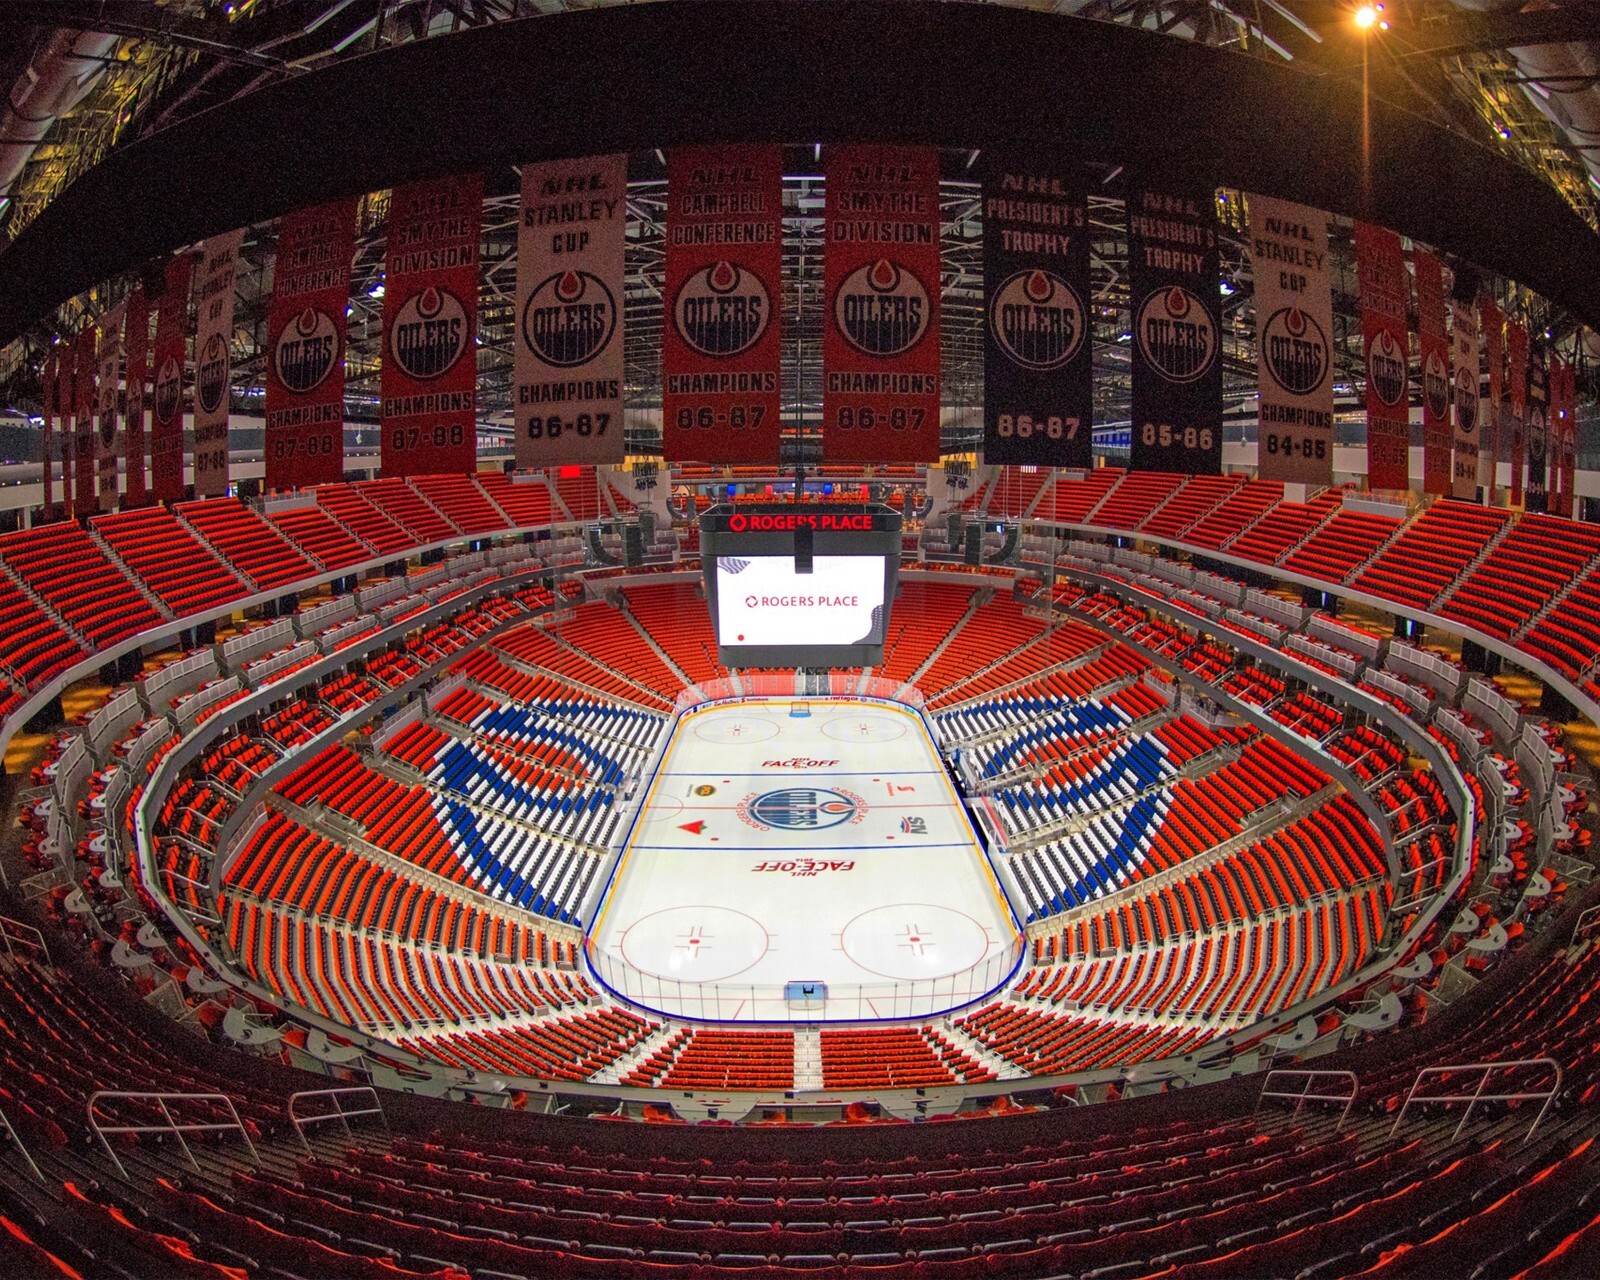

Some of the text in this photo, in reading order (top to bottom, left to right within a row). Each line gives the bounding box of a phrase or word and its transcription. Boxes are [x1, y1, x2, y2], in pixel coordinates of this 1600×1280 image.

[541, 174, 607, 196] NHL
[690, 166, 761, 184] NHL
[849, 164, 919, 184] NHL
[1002, 172, 1066, 196] NHL
[524, 198, 618, 228] STANLEY
[680, 192, 768, 216] CAMPBELL
[838, 191, 928, 214] SMYTHE
[672, 222, 776, 246] CONFERENCE
[832, 221, 932, 244] DIVISION
[1265, 216, 1314, 242] NHL
[552, 231, 589, 254] CUP
[1001, 230, 1070, 256] TROPHY
[391, 244, 474, 276] DIVISION
[1144, 246, 1204, 275] TROPHY
[1254, 241, 1325, 272] STANLEY
[277, 268, 348, 298] CONFERENCE
[1280, 271, 1308, 293] CUP
[533, 303, 606, 337] OILERS
[682, 295, 762, 324] OILERS
[844, 294, 922, 324] OILERS
[1001, 303, 1074, 336] OILERS
[397, 318, 461, 348] OILERS
[1146, 318, 1208, 350] OILERS
[279, 334, 332, 366] OILERS
[1271, 335, 1322, 368] OILERS
[520, 380, 619, 404] CHAMPIONS
[668, 372, 776, 395] CHAMPIONS
[828, 372, 936, 396] CHAMPIONS
[268, 404, 340, 431] CHAMPIONS
[384, 391, 474, 420] CHAMPIONS
[676, 406, 767, 431] 86-87
[1261, 404, 1332, 430] CHAMPIONS
[528, 414, 611, 440] 86-87
[836, 406, 926, 432] 86-87
[996, 414, 1081, 441] 86-87
[274, 434, 334, 460] 87-88
[391, 424, 465, 452] 87-88
[1142, 422, 1213, 450] 85-86
[1266, 434, 1326, 460] 84-85
[750, 516, 872, 530] ROGERS PLACE
[762, 596, 858, 606] ROGERS PLACE
[907, 816, 928, 834] SN
[751, 861, 855, 872] FACE-OFF
